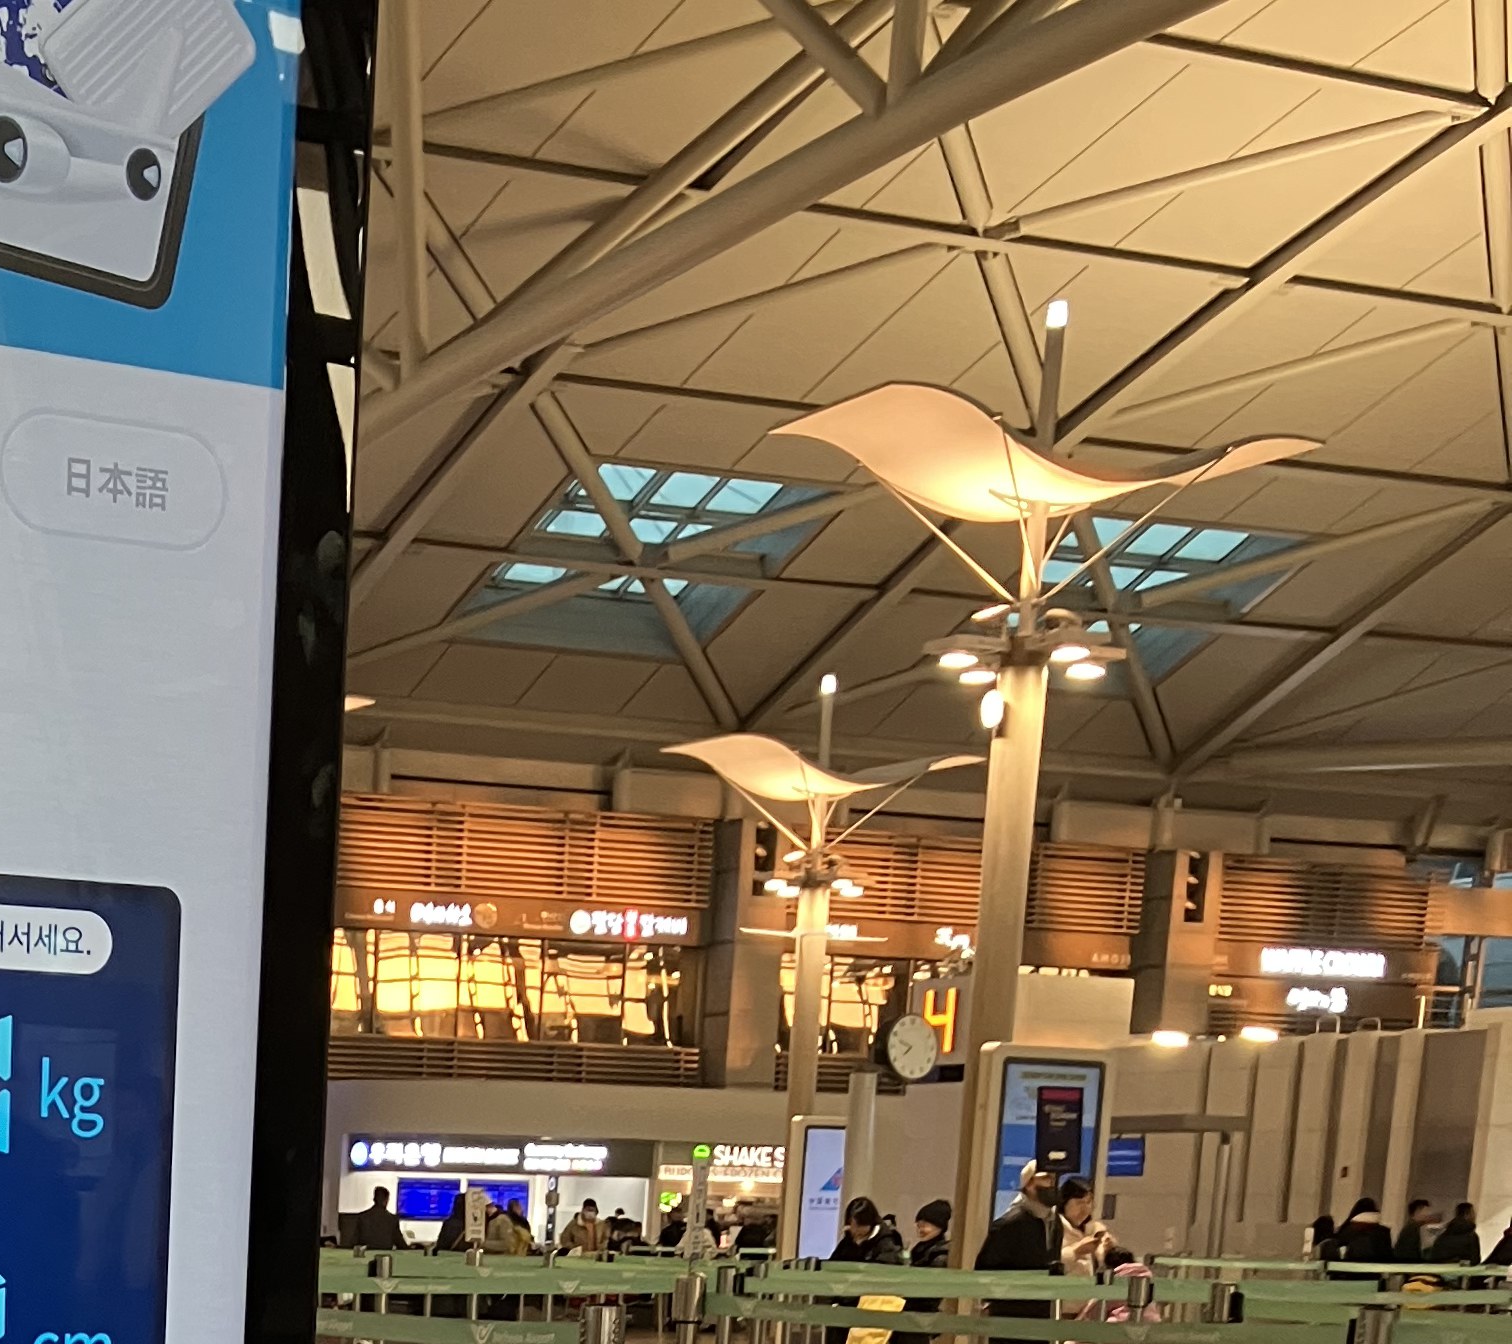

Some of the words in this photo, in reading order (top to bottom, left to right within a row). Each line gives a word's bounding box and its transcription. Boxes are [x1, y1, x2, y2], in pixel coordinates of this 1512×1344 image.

[64, 458, 169, 513] 日本語
[924, 987, 958, 1053] 4
[39, 1057, 105, 1139] kg
[713, 1144, 773, 1167] SHAKE
